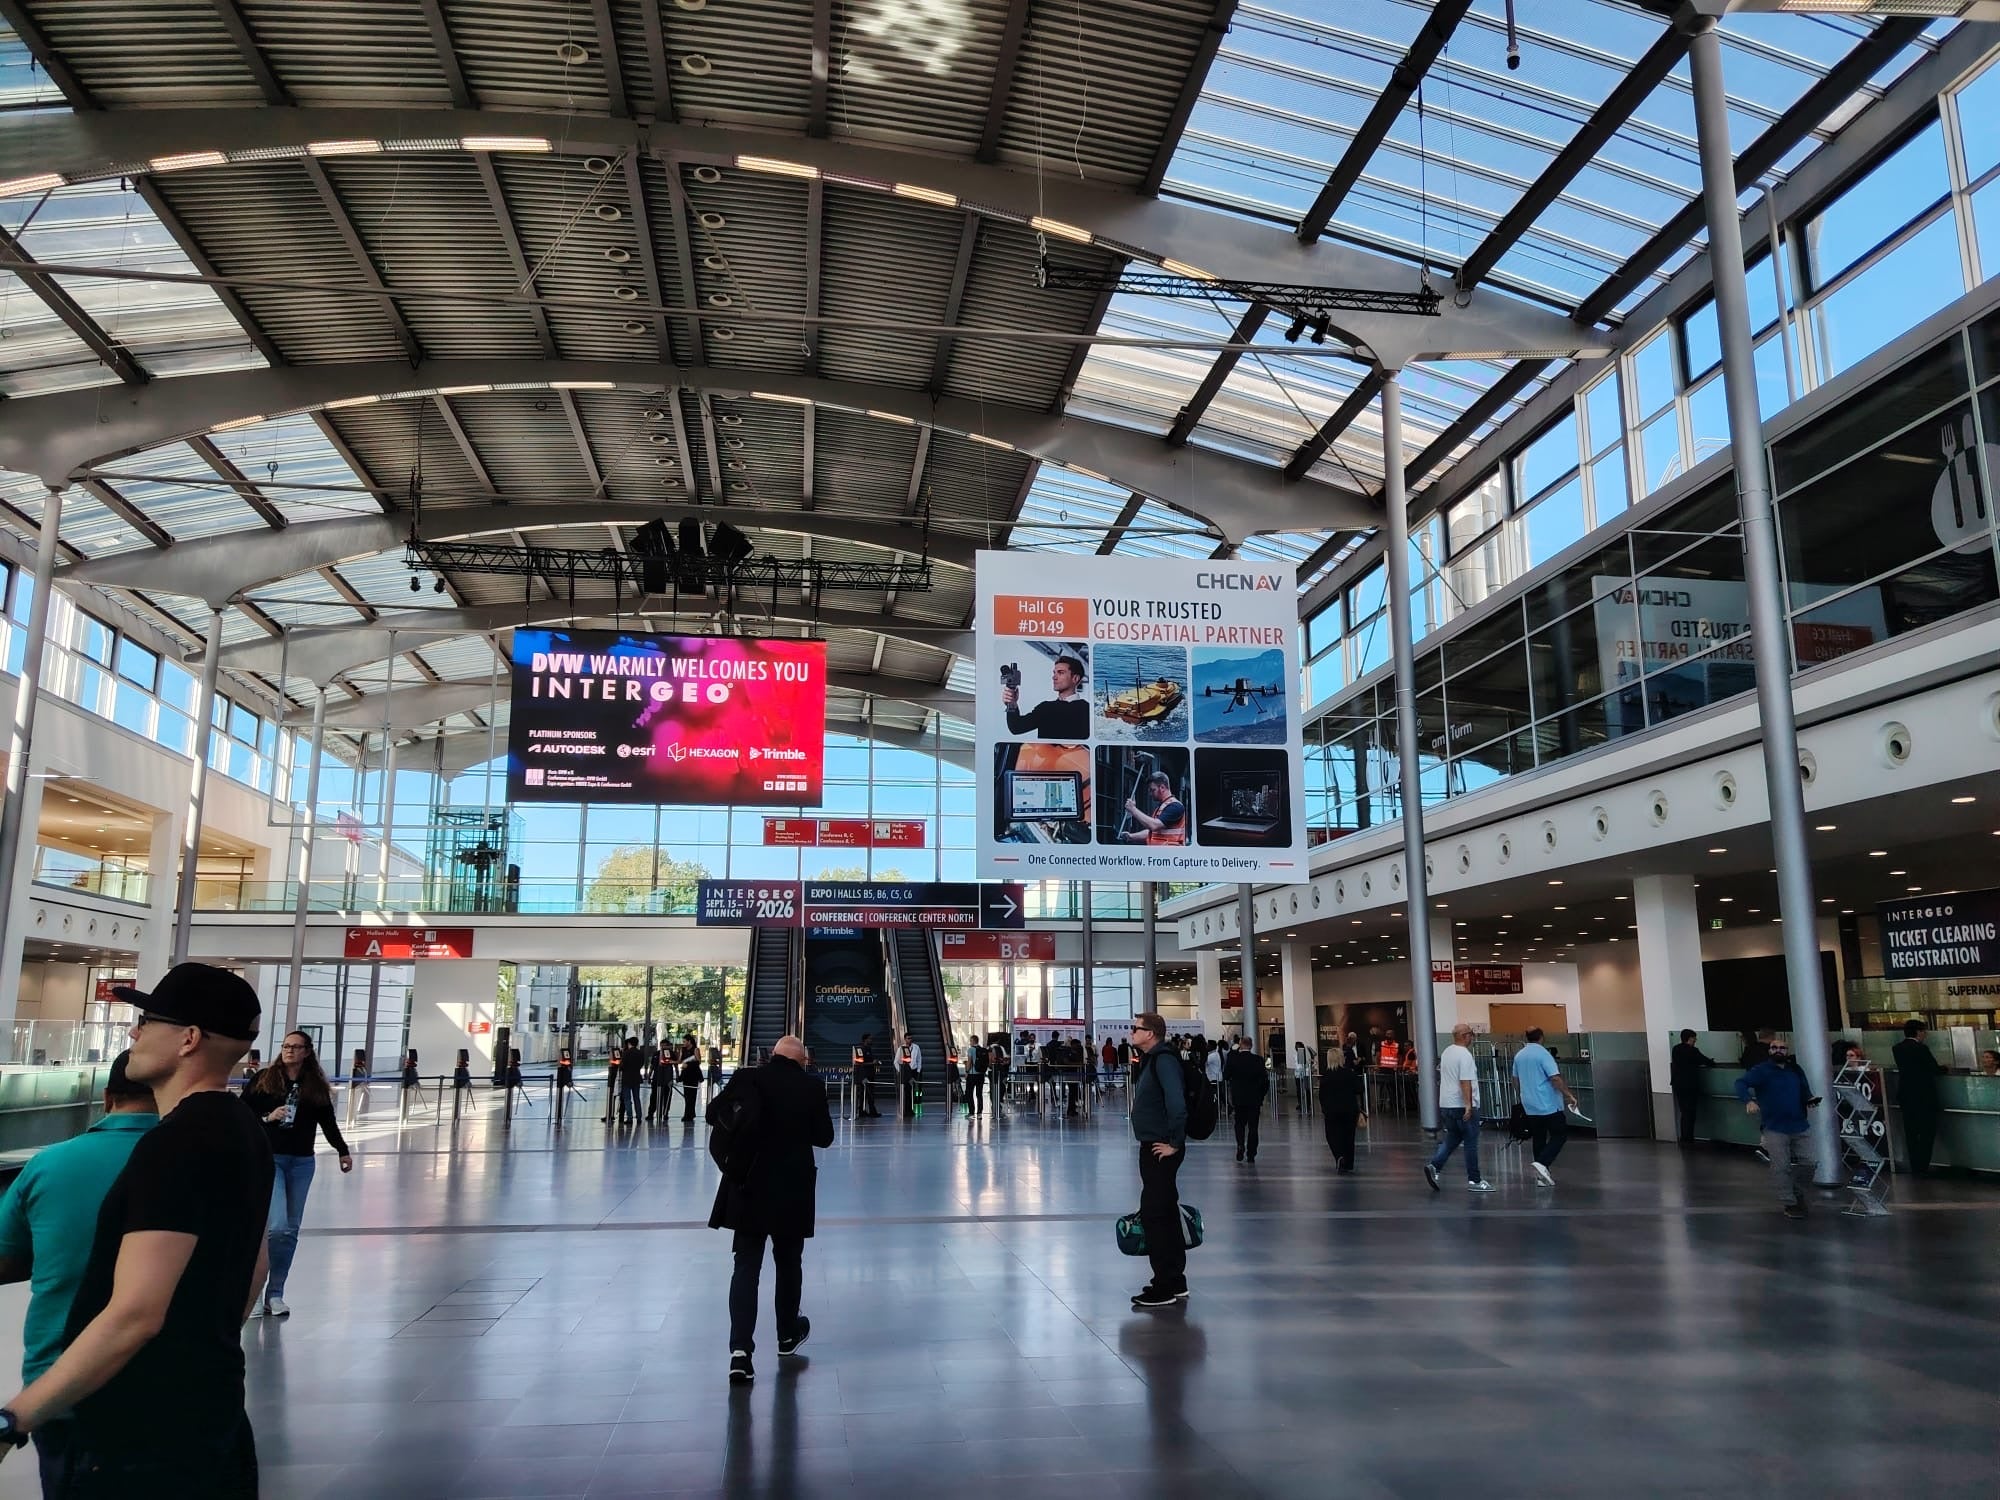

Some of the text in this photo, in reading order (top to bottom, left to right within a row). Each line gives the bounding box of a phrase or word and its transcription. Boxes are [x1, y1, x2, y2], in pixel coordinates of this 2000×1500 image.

[1196, 572, 1282, 591] CHCNAV
[1018, 600, 1064, 615] Hall C6
[1092, 598, 1222, 620] YOUR TRUSTED
[1018, 620, 1064, 634] #D149
[1093, 622, 1284, 645] GEOSPATIAL PARTNER
[532, 653, 809, 682] DVW WARMLY WELCOMES YOU
[529, 730, 597, 740] PLATINUM SPONSORS
[1432, 722, 1472, 749] am Turm
[543, 744, 606, 755] AUTODESK
[632, 744, 656, 756] esri
[689, 748, 739, 758] HEXAGON
[762, 748, 806, 760] Trimble
[1028, 854, 1260, 870] One Connected Workflow. From Capture to Delivery.
[811, 889, 912, 900] EXPO HALLS B5, B6, C5, C6
[706, 900, 725, 908] SEPT.
[756, 900, 794, 918] 2026
[706, 909, 742, 918] MUNICH
[810, 912, 973, 922] CONFERENCE CONFERENCE CENTER NORTH
[1888, 906, 1953, 922] INTERGEO
[1888, 923, 1996, 948] TICKET CLEARING
[365, 939, 382, 956] A
[1891, 946, 1980, 968] REGISTRATION
[815, 985, 870, 994] Confidence
[816, 994, 824, 1003] at
[827, 995, 852, 1006] every
